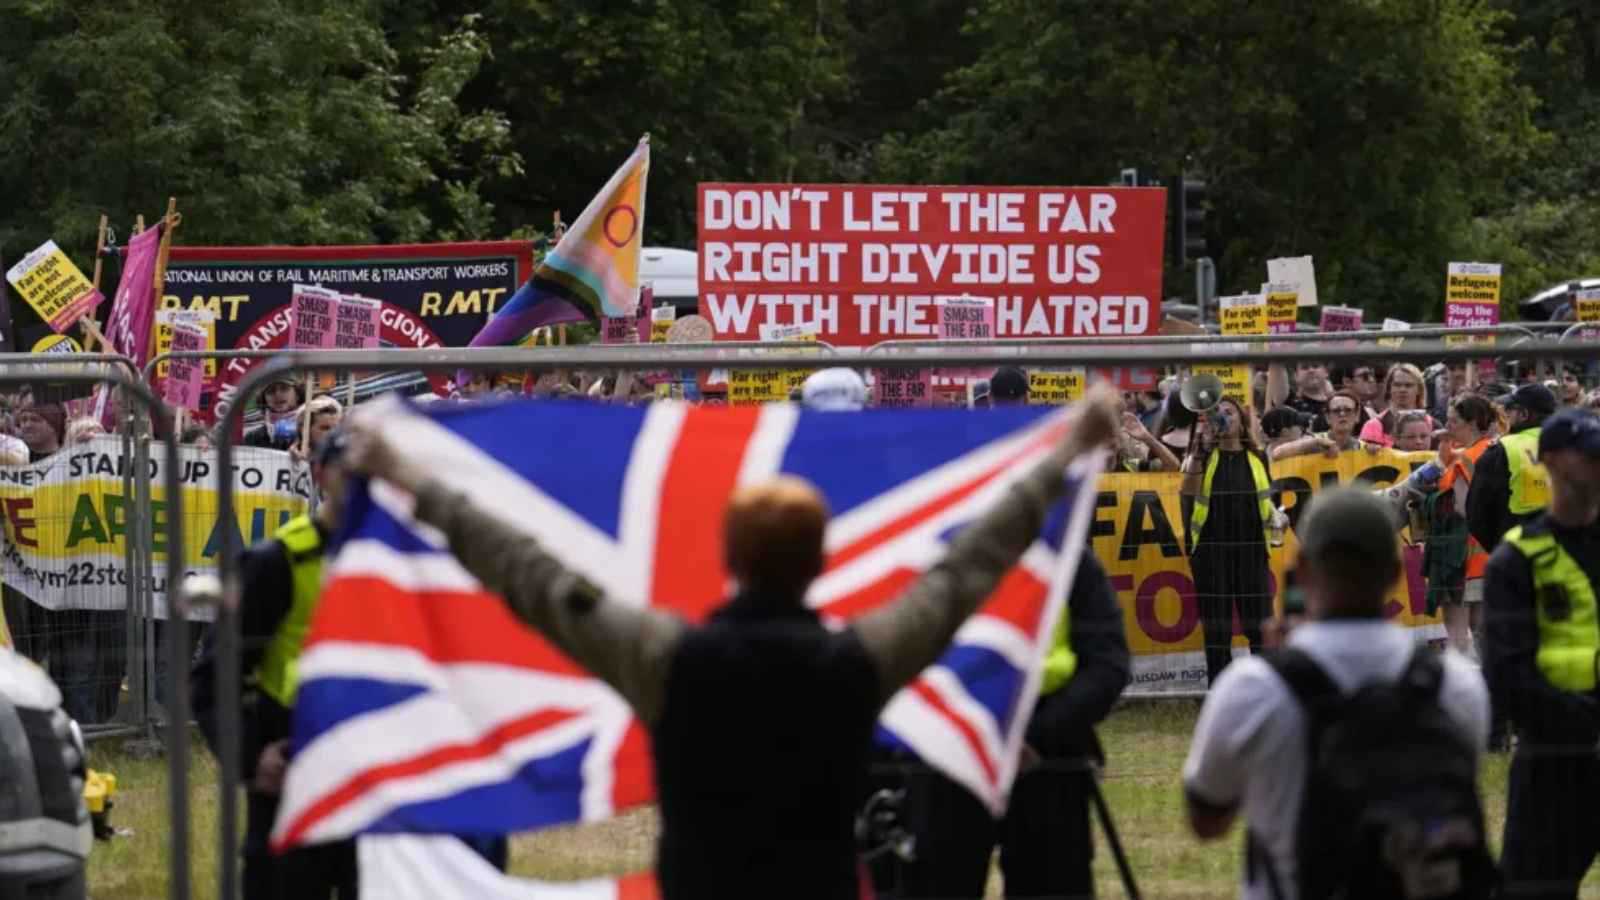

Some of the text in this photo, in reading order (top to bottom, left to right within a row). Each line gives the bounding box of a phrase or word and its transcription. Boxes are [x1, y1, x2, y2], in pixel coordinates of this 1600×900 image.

[704, 188, 1118, 233] DON'T LET THE FAR
[704, 242, 1101, 284] RIGHT DIVIDE US
[163, 269, 213, 283] ATIONAL
[216, 269, 253, 282] UNION
[258, 269, 272, 282] OF
[277, 269, 303, 282] RAIL
[309, 268, 369, 282] MARITIME
[382, 266, 448, 281] TRANSPORT
[454, 262, 508, 279] WORKERS
[1450, 276, 1497, 289] Refugees
[1450, 289, 1494, 299] welcome
[420, 288, 507, 321] RMT
[705, 293, 838, 335] WITH
[852, 294, 938, 335] THE
[997, 296, 1149, 336] HATRED
[944, 306, 984, 321] SMASH
[944, 323, 990, 337] THE FAR
[1030, 375, 1077, 388] Far right
[880, 383, 926, 398] THE FAR
[1030, 389, 1069, 399] are not
